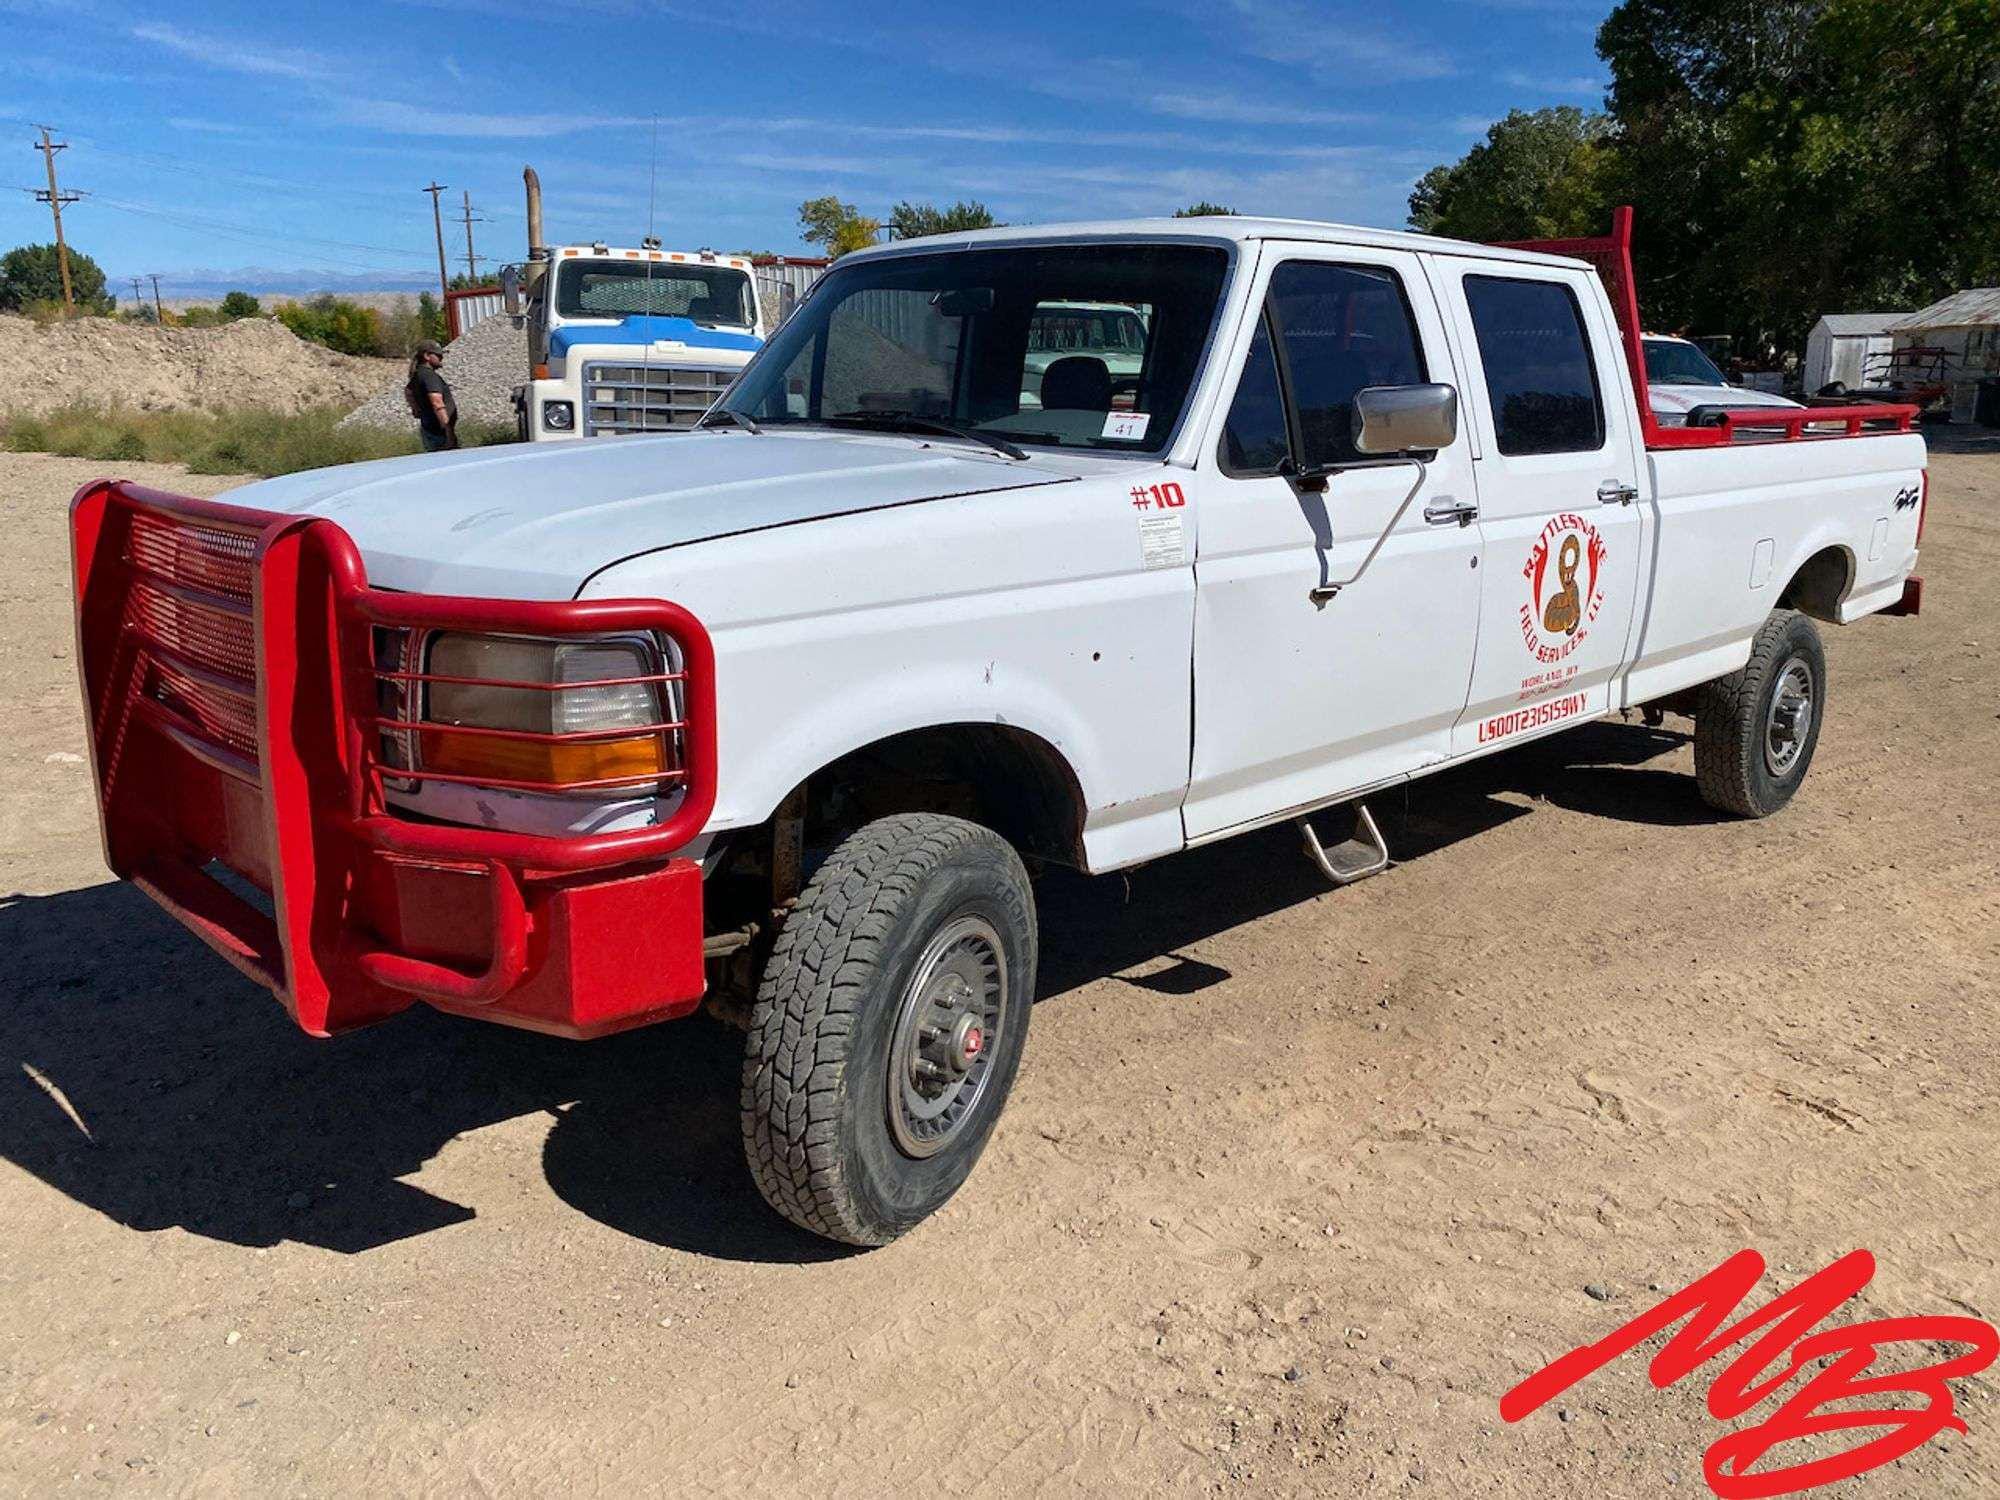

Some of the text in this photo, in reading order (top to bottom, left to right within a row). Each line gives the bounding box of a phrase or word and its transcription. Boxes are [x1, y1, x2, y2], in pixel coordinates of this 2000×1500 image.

[1130, 482, 1185, 510] #10
[1523, 513, 1608, 579] RATTLESNAKE
[1520, 604, 1538, 651] FIELD
